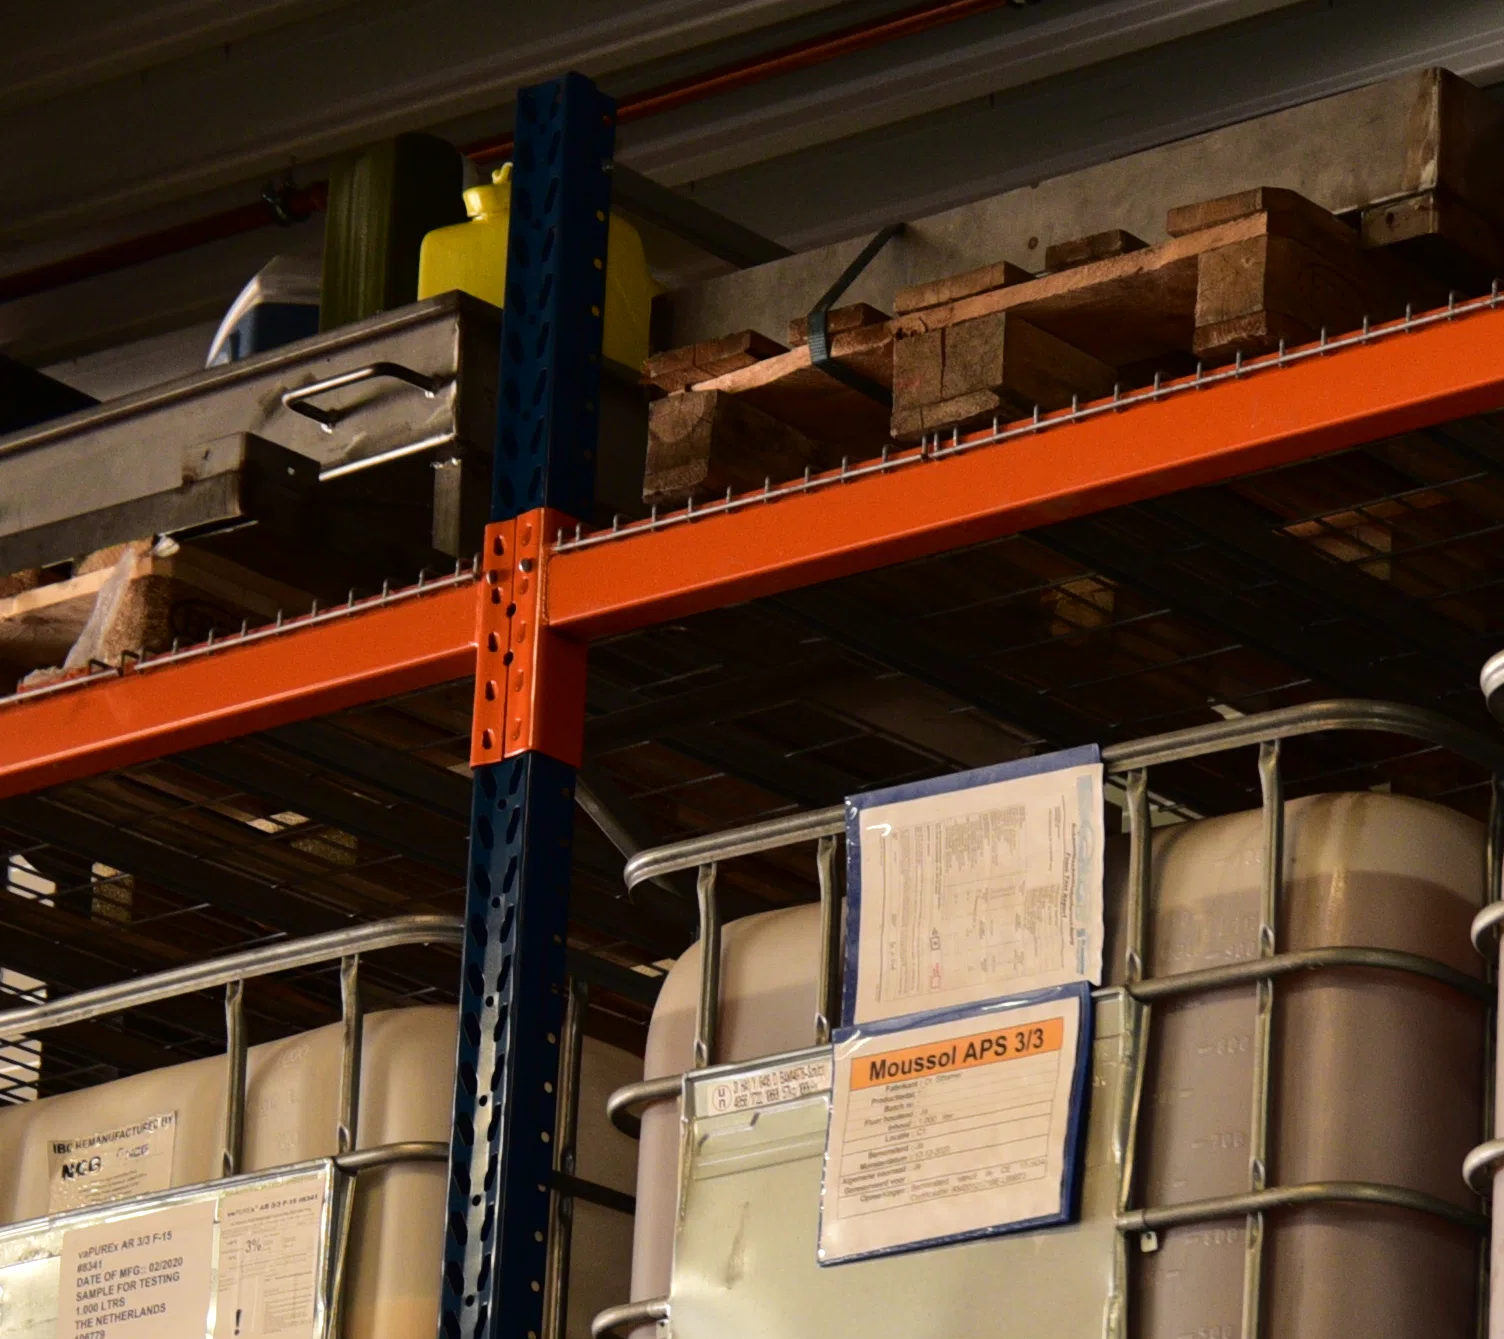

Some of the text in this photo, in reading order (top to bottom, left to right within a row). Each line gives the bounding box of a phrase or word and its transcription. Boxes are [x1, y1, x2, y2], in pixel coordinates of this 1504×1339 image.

[868, 1027, 1045, 1083] Moussol APS 3/3
[121, 1238, 135, 1250] AR
[137, 1236, 150, 1247] 3/3
[153, 1231, 172, 1244] F-15
[76, 1271, 180, 1301] SAMPLE FOR TESTING
[77, 1275, 102, 1288] DATE
[104, 1269, 117, 1282] OF
[149, 1257, 183, 1273] 02/2020
[75, 1303, 166, 1331] THE NETHERLANDS
[76, 1298, 125, 1316] 1.000 LTRS
